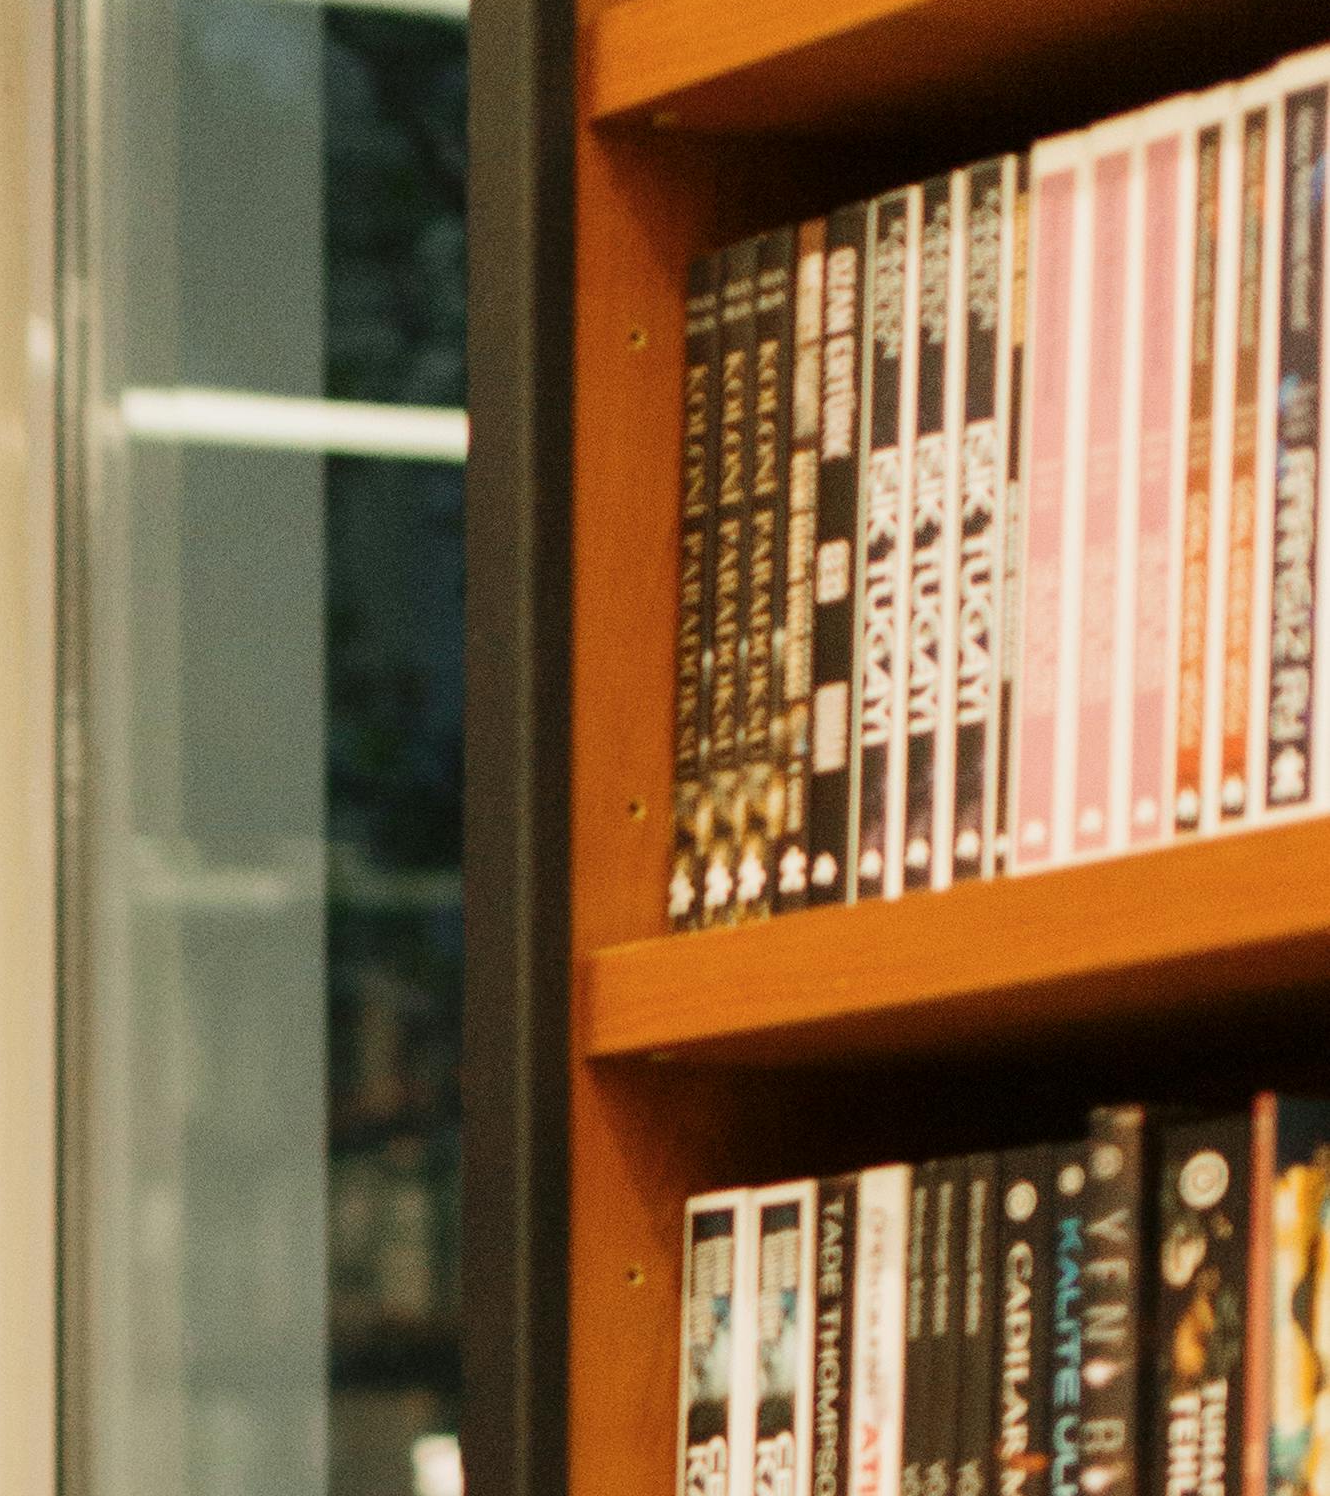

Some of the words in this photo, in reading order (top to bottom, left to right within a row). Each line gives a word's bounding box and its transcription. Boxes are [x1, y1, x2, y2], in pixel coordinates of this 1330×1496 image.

[861, 554, 895, 746] TUGAYI
[908, 543, 941, 735] TUGAYI
[957, 533, 994, 725] TUGAYI
[818, 1194, 846, 1297] TADE
[1000, 1240, 1035, 1457] CADILAR
